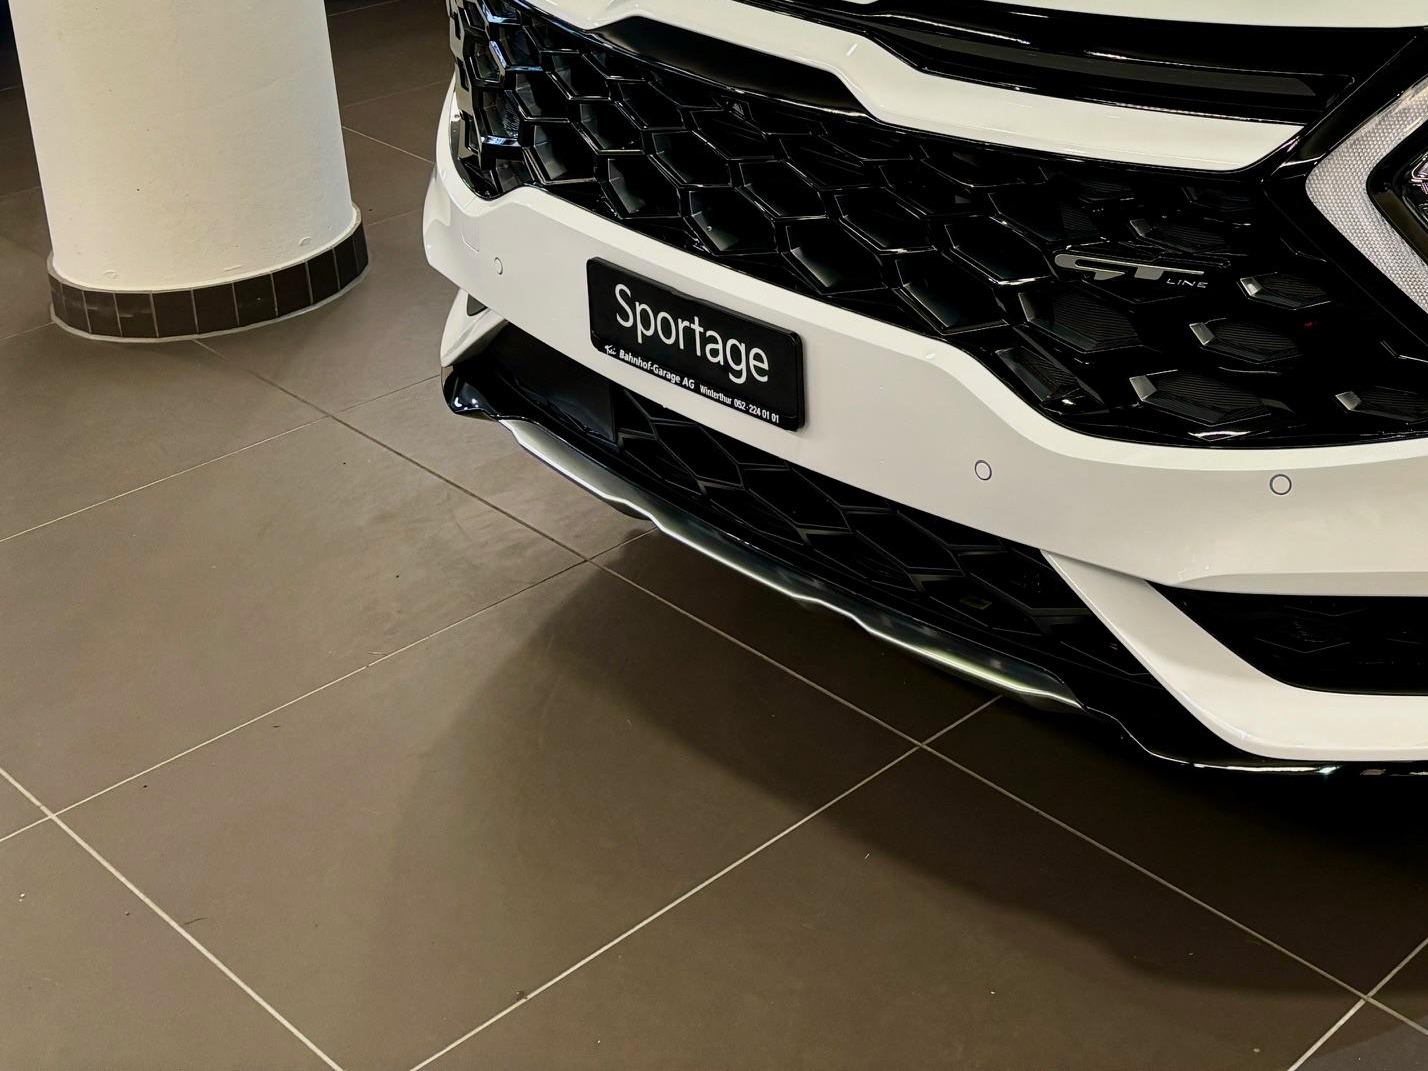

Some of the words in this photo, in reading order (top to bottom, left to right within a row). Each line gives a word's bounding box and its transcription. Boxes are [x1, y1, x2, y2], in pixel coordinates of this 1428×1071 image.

[1054, 254, 1205, 281] GT
[1166, 278, 1208, 289] LINE
[614, 283, 769, 385] Sportage
[619, 349, 681, 384] Bahnhof-Garage
[682, 376, 696, 390] AG
[700, 383, 733, 405] Winterthur
[762, 409, 770, 420] 01
[771, 413, 780, 424] 01
